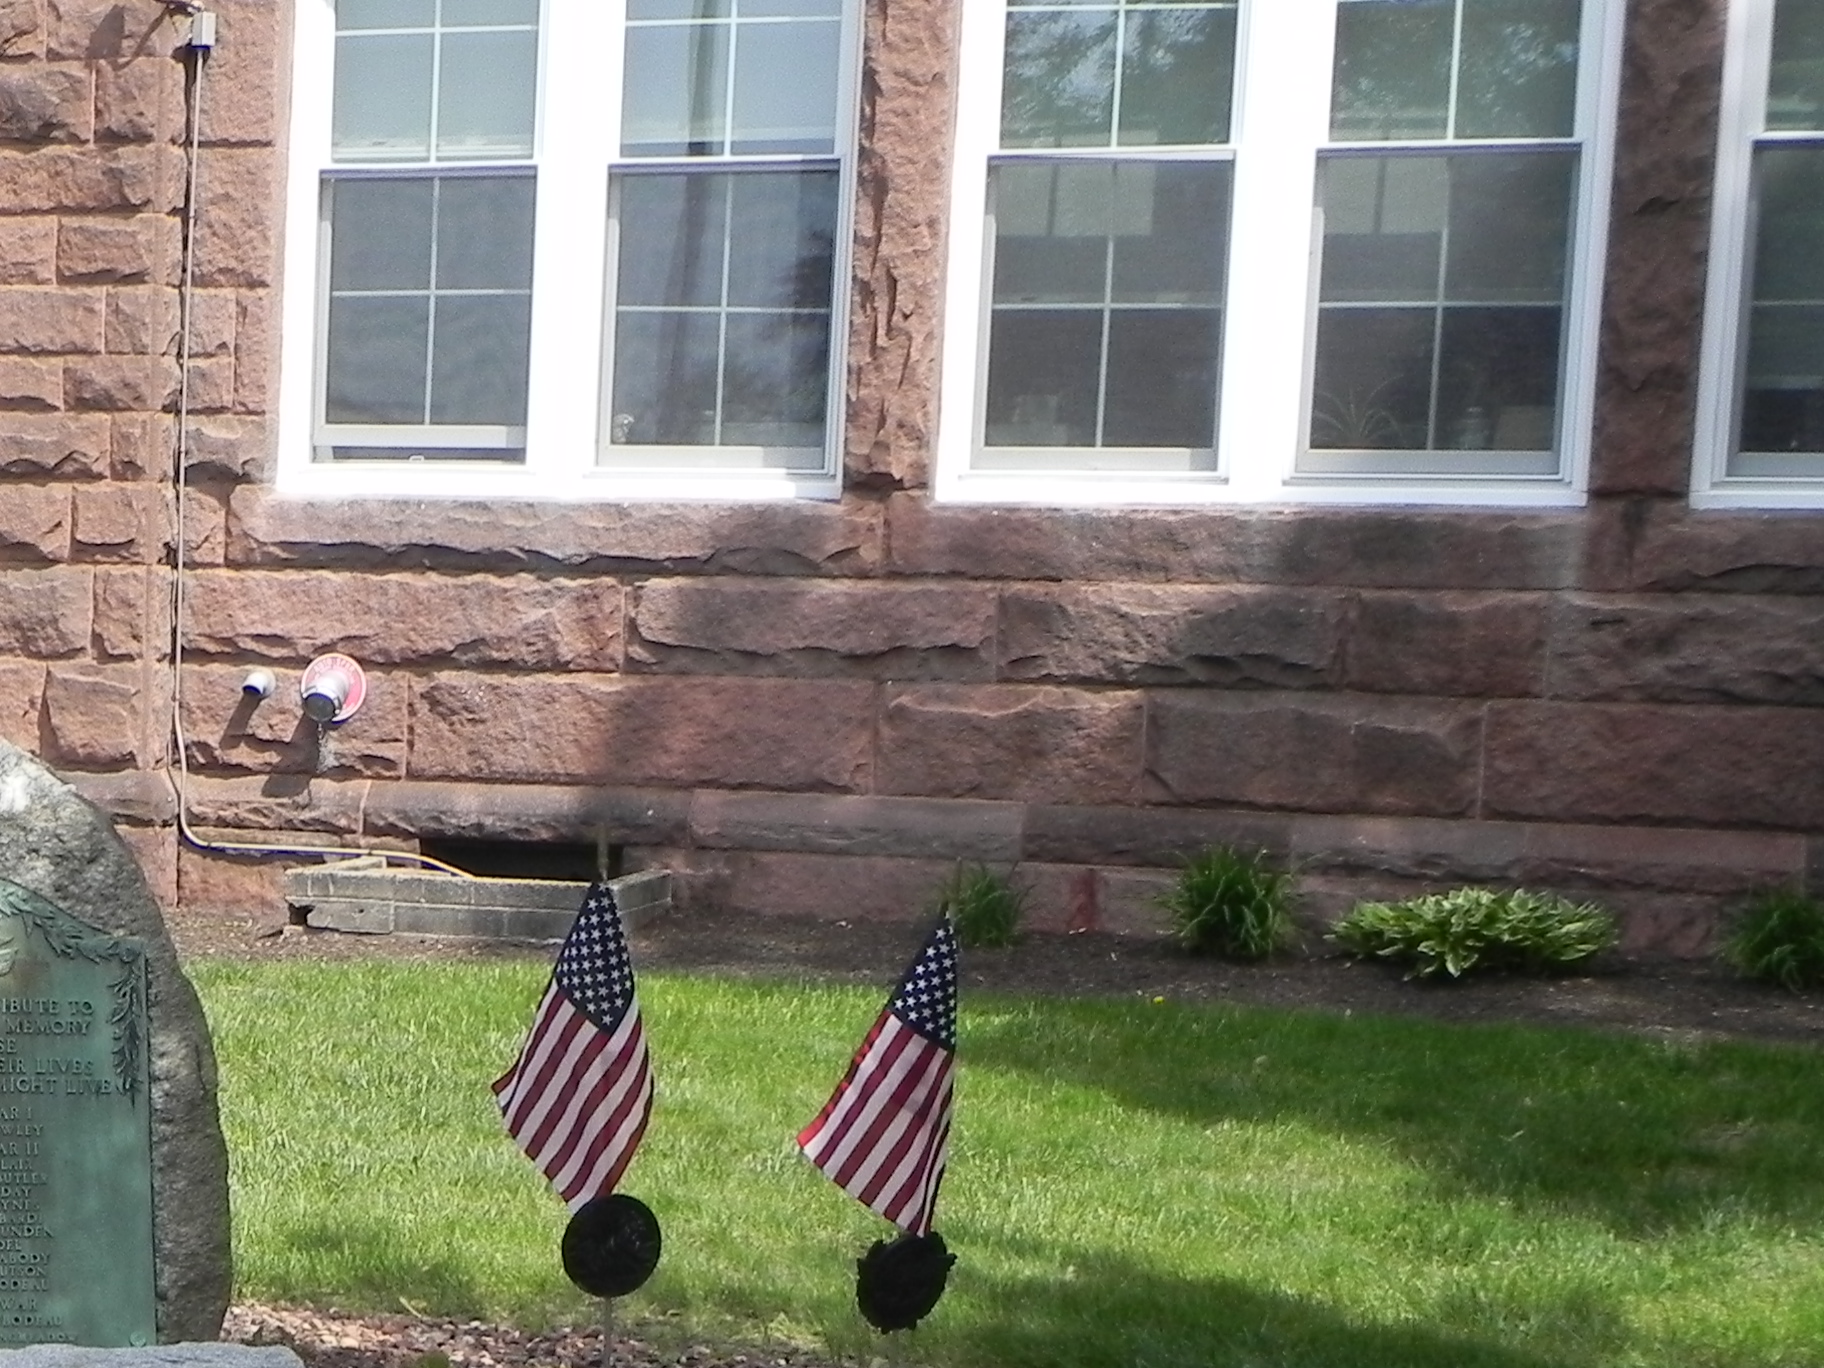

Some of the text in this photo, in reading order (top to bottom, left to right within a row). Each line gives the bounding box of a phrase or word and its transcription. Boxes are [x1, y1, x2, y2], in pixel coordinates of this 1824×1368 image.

[67, 1000, 94, 1016] TO
[5, 1018, 90, 1035] MEMORY
[35, 1058, 94, 1076] LIVES
[65, 1079, 112, 1095] LIVE
[26, 1105, 33, 1119] I
[24, 1141, 41, 1155] II
[1, 1186, 33, 1198] DAY
